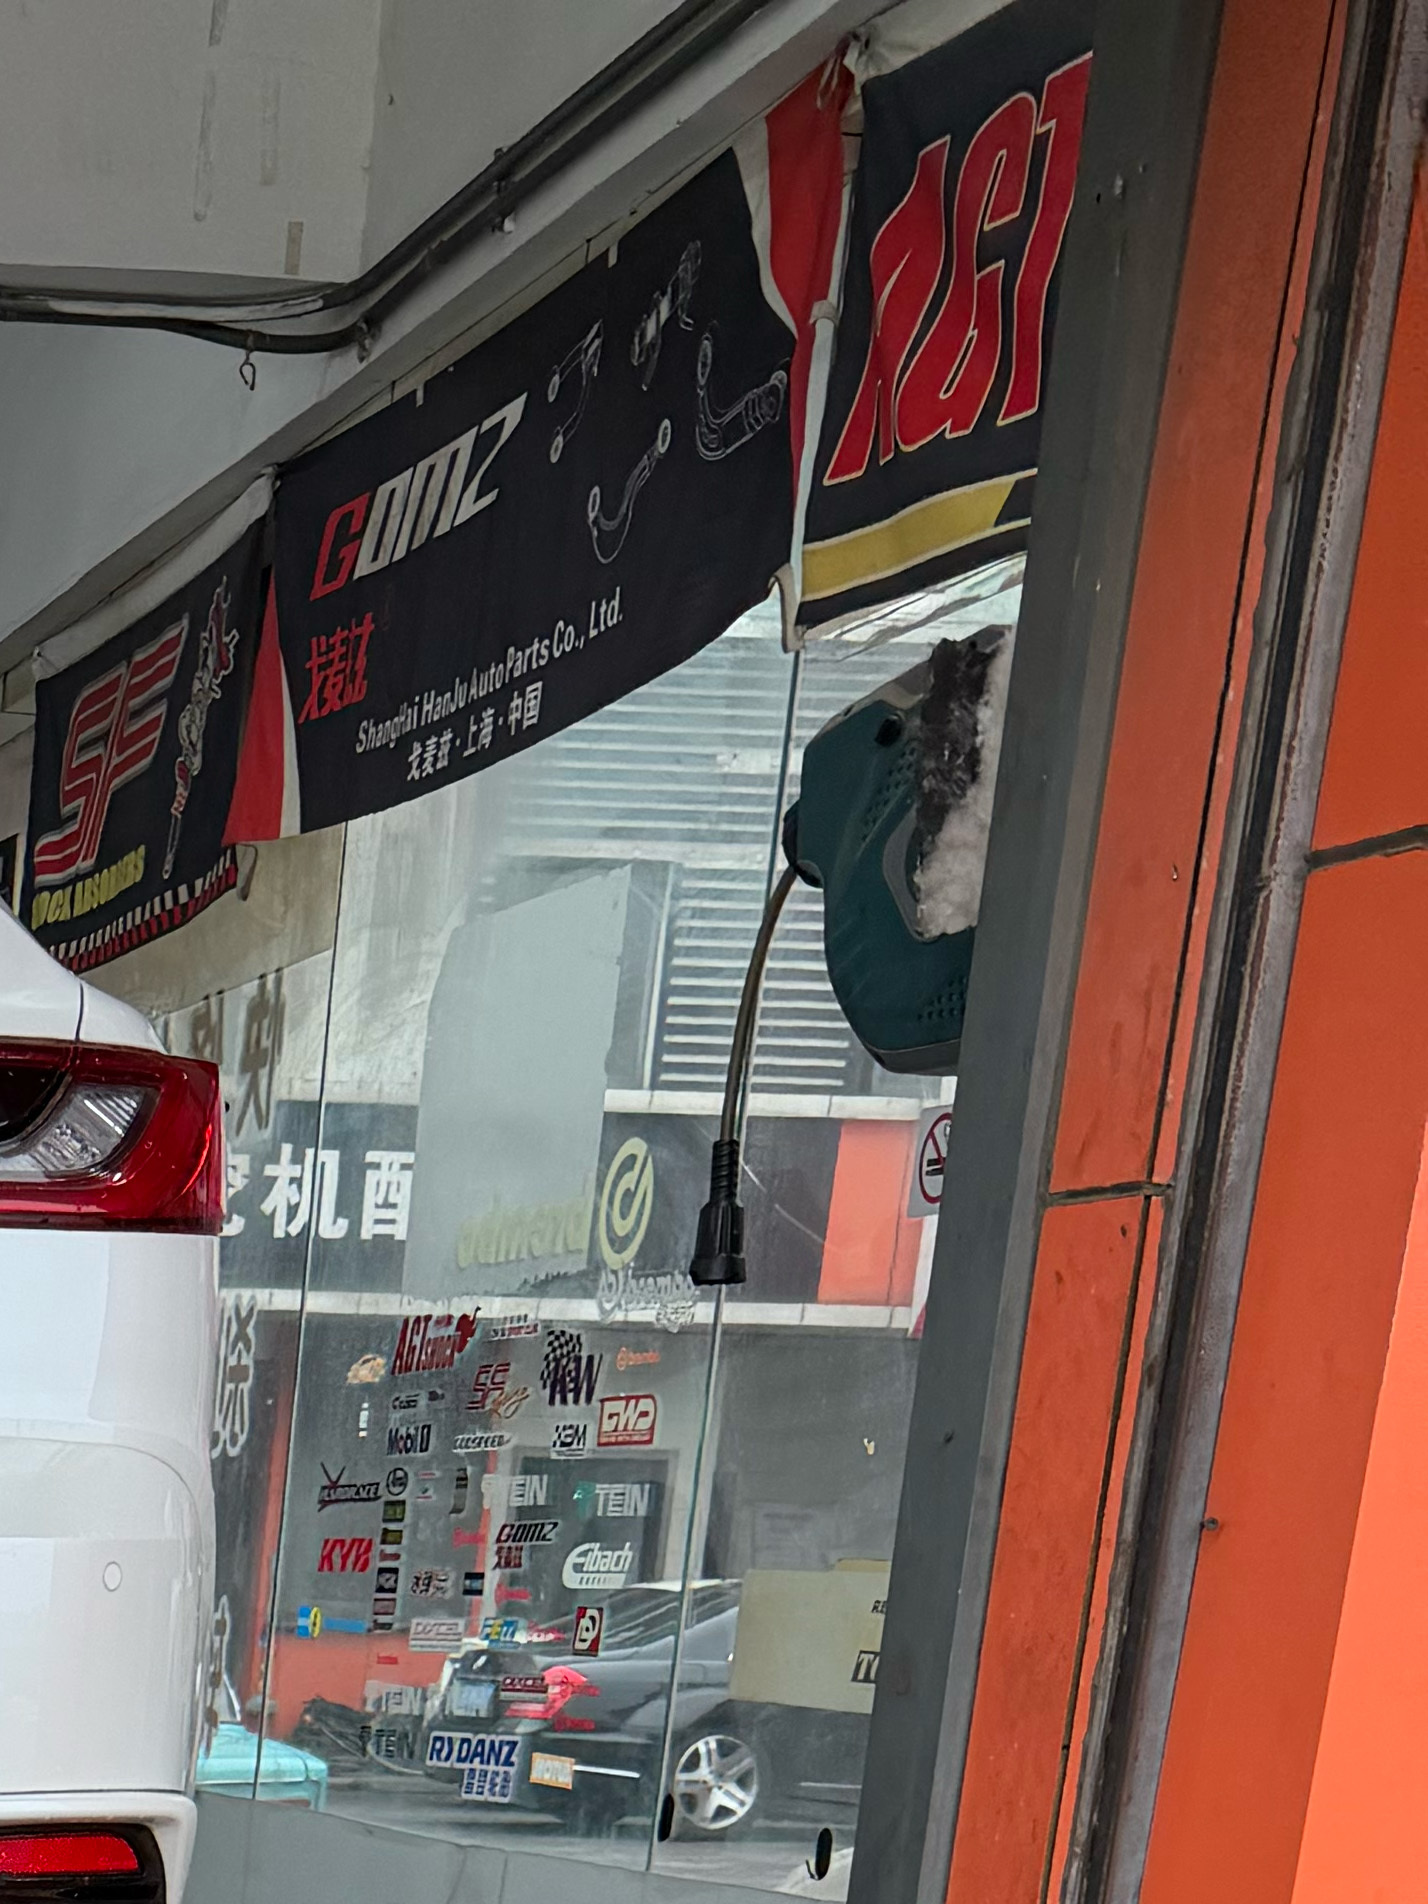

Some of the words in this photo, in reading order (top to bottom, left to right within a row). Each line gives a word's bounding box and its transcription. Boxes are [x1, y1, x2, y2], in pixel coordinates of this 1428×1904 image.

[310, 391, 528, 601] GOMZ
[588, 585, 624, 640] Ltd.
[595, 1483, 651, 1517] TEIN
[317, 1537, 374, 1573] KYB
[562, 1542, 634, 1589] Eibach
